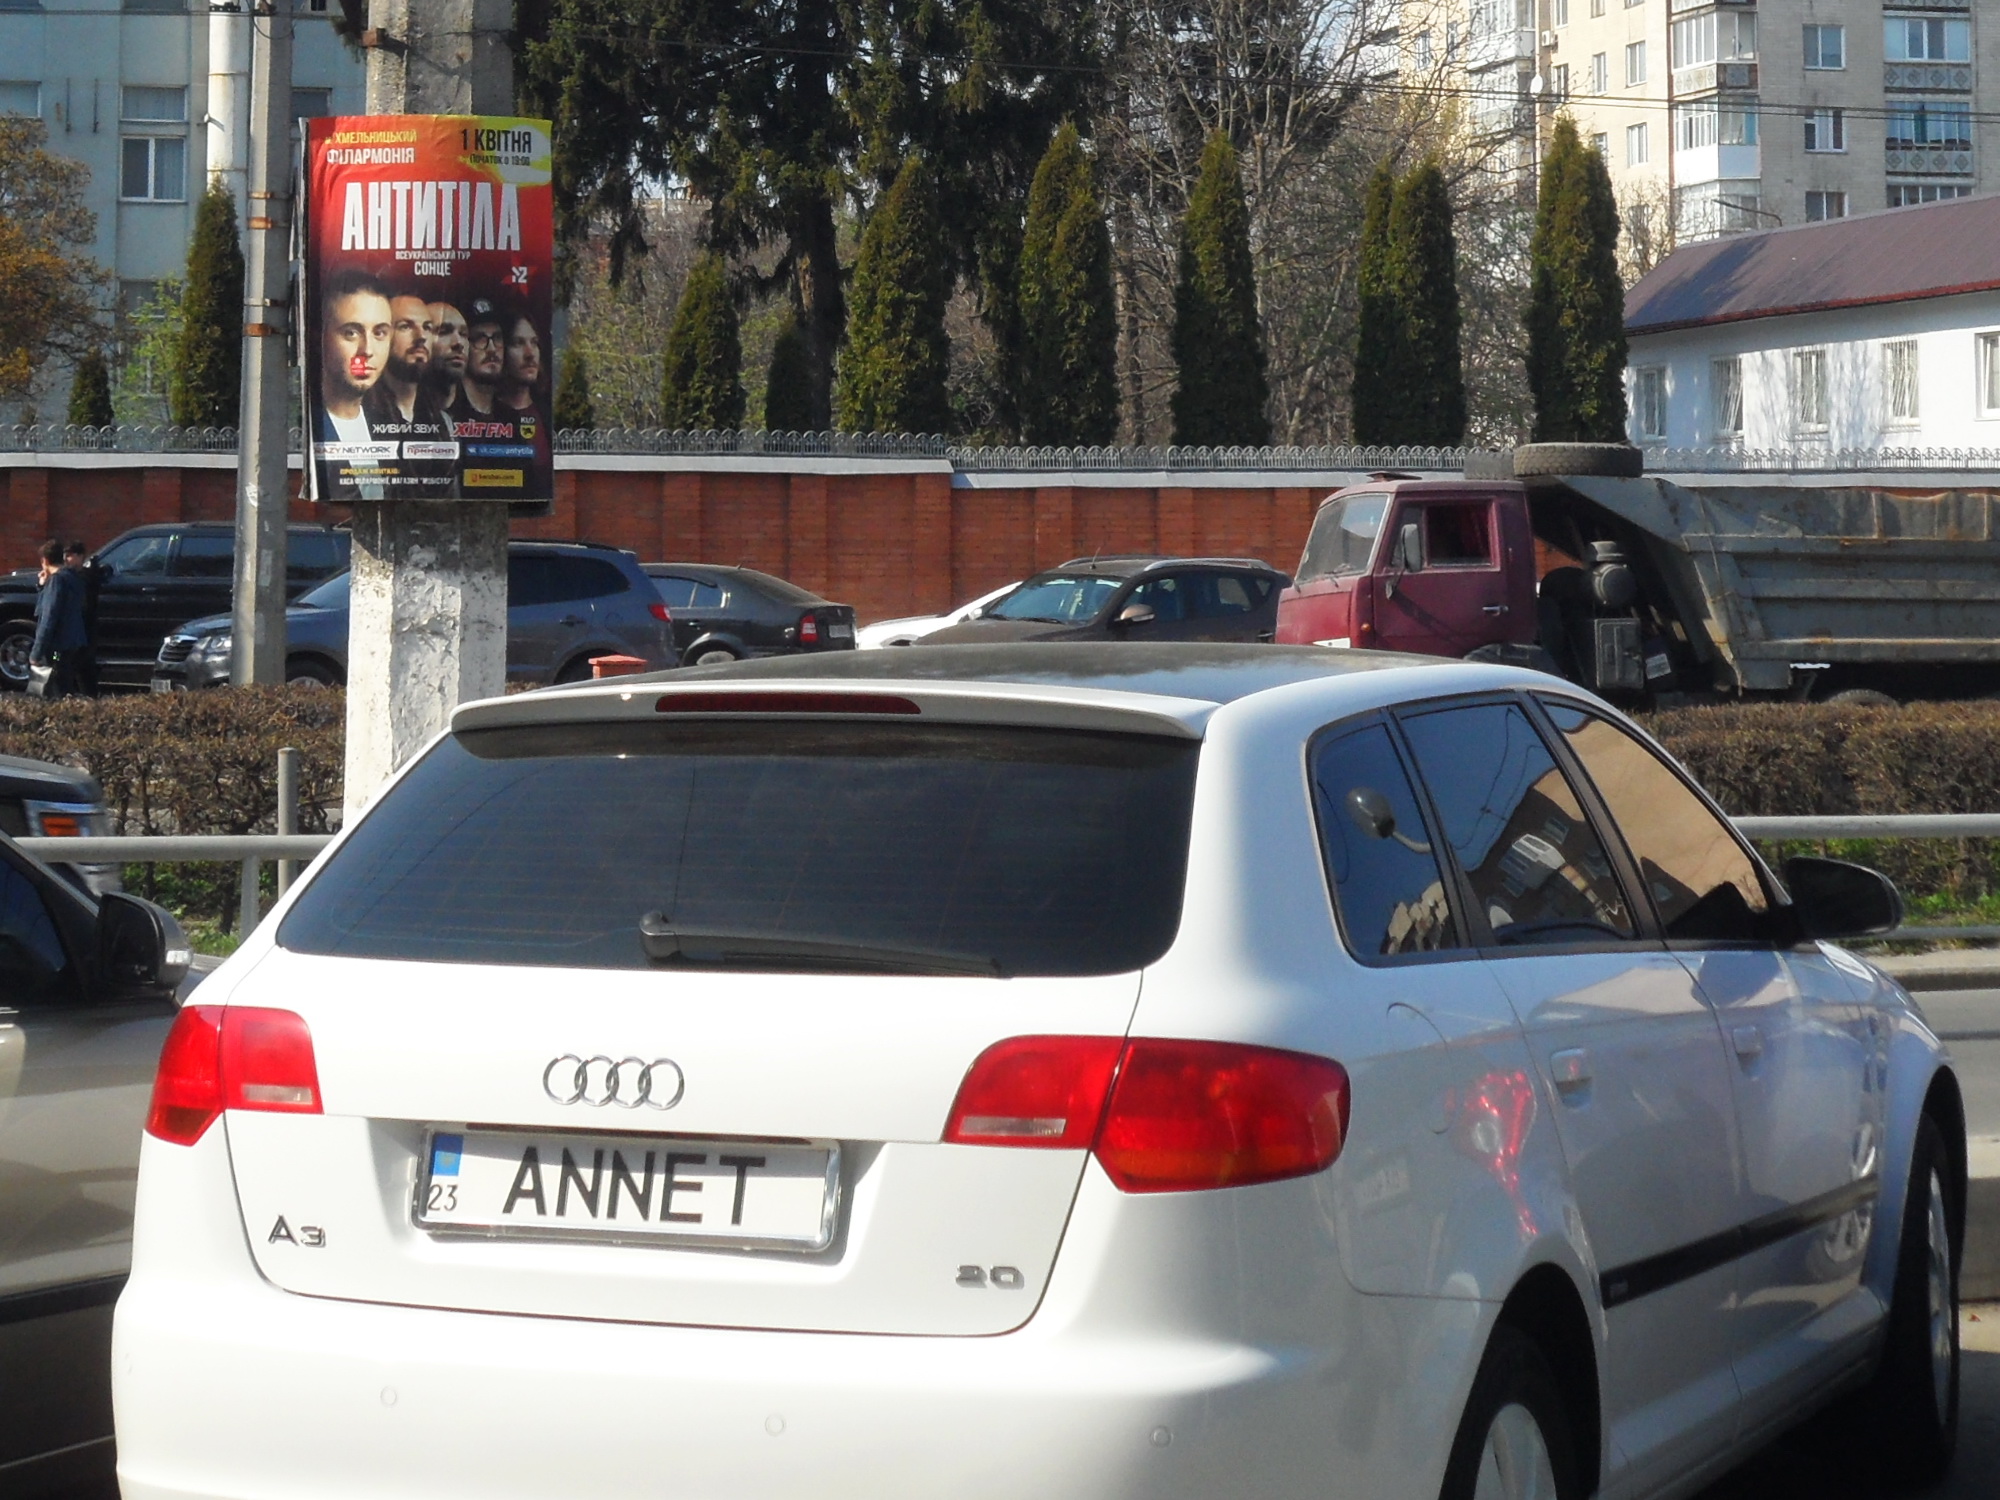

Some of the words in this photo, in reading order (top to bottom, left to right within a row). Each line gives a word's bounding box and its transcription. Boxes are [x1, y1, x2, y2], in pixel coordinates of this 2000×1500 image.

[334, 129, 417, 144] ХМЕЛЬНИЦЬКИЙ
[461, 128, 468, 150] 1
[474, 128, 532, 153] КВІТНЯ
[326, 147, 415, 165] ФІЛАРМОНІЯ
[341, 181, 521, 251] АНТИТІЛА
[457, 251, 471, 260] ТУР
[414, 261, 451, 277] СОНЦЕ
[372, 422, 412, 434] ЖИВИЙ
[413, 423, 440, 434] ЗВУК
[342, 446, 391, 454] NETWORK
[502, 1146, 766, 1225] ANNET
[428, 1184, 458, 1211] 23
[268, 1215, 326, 1247] A3
